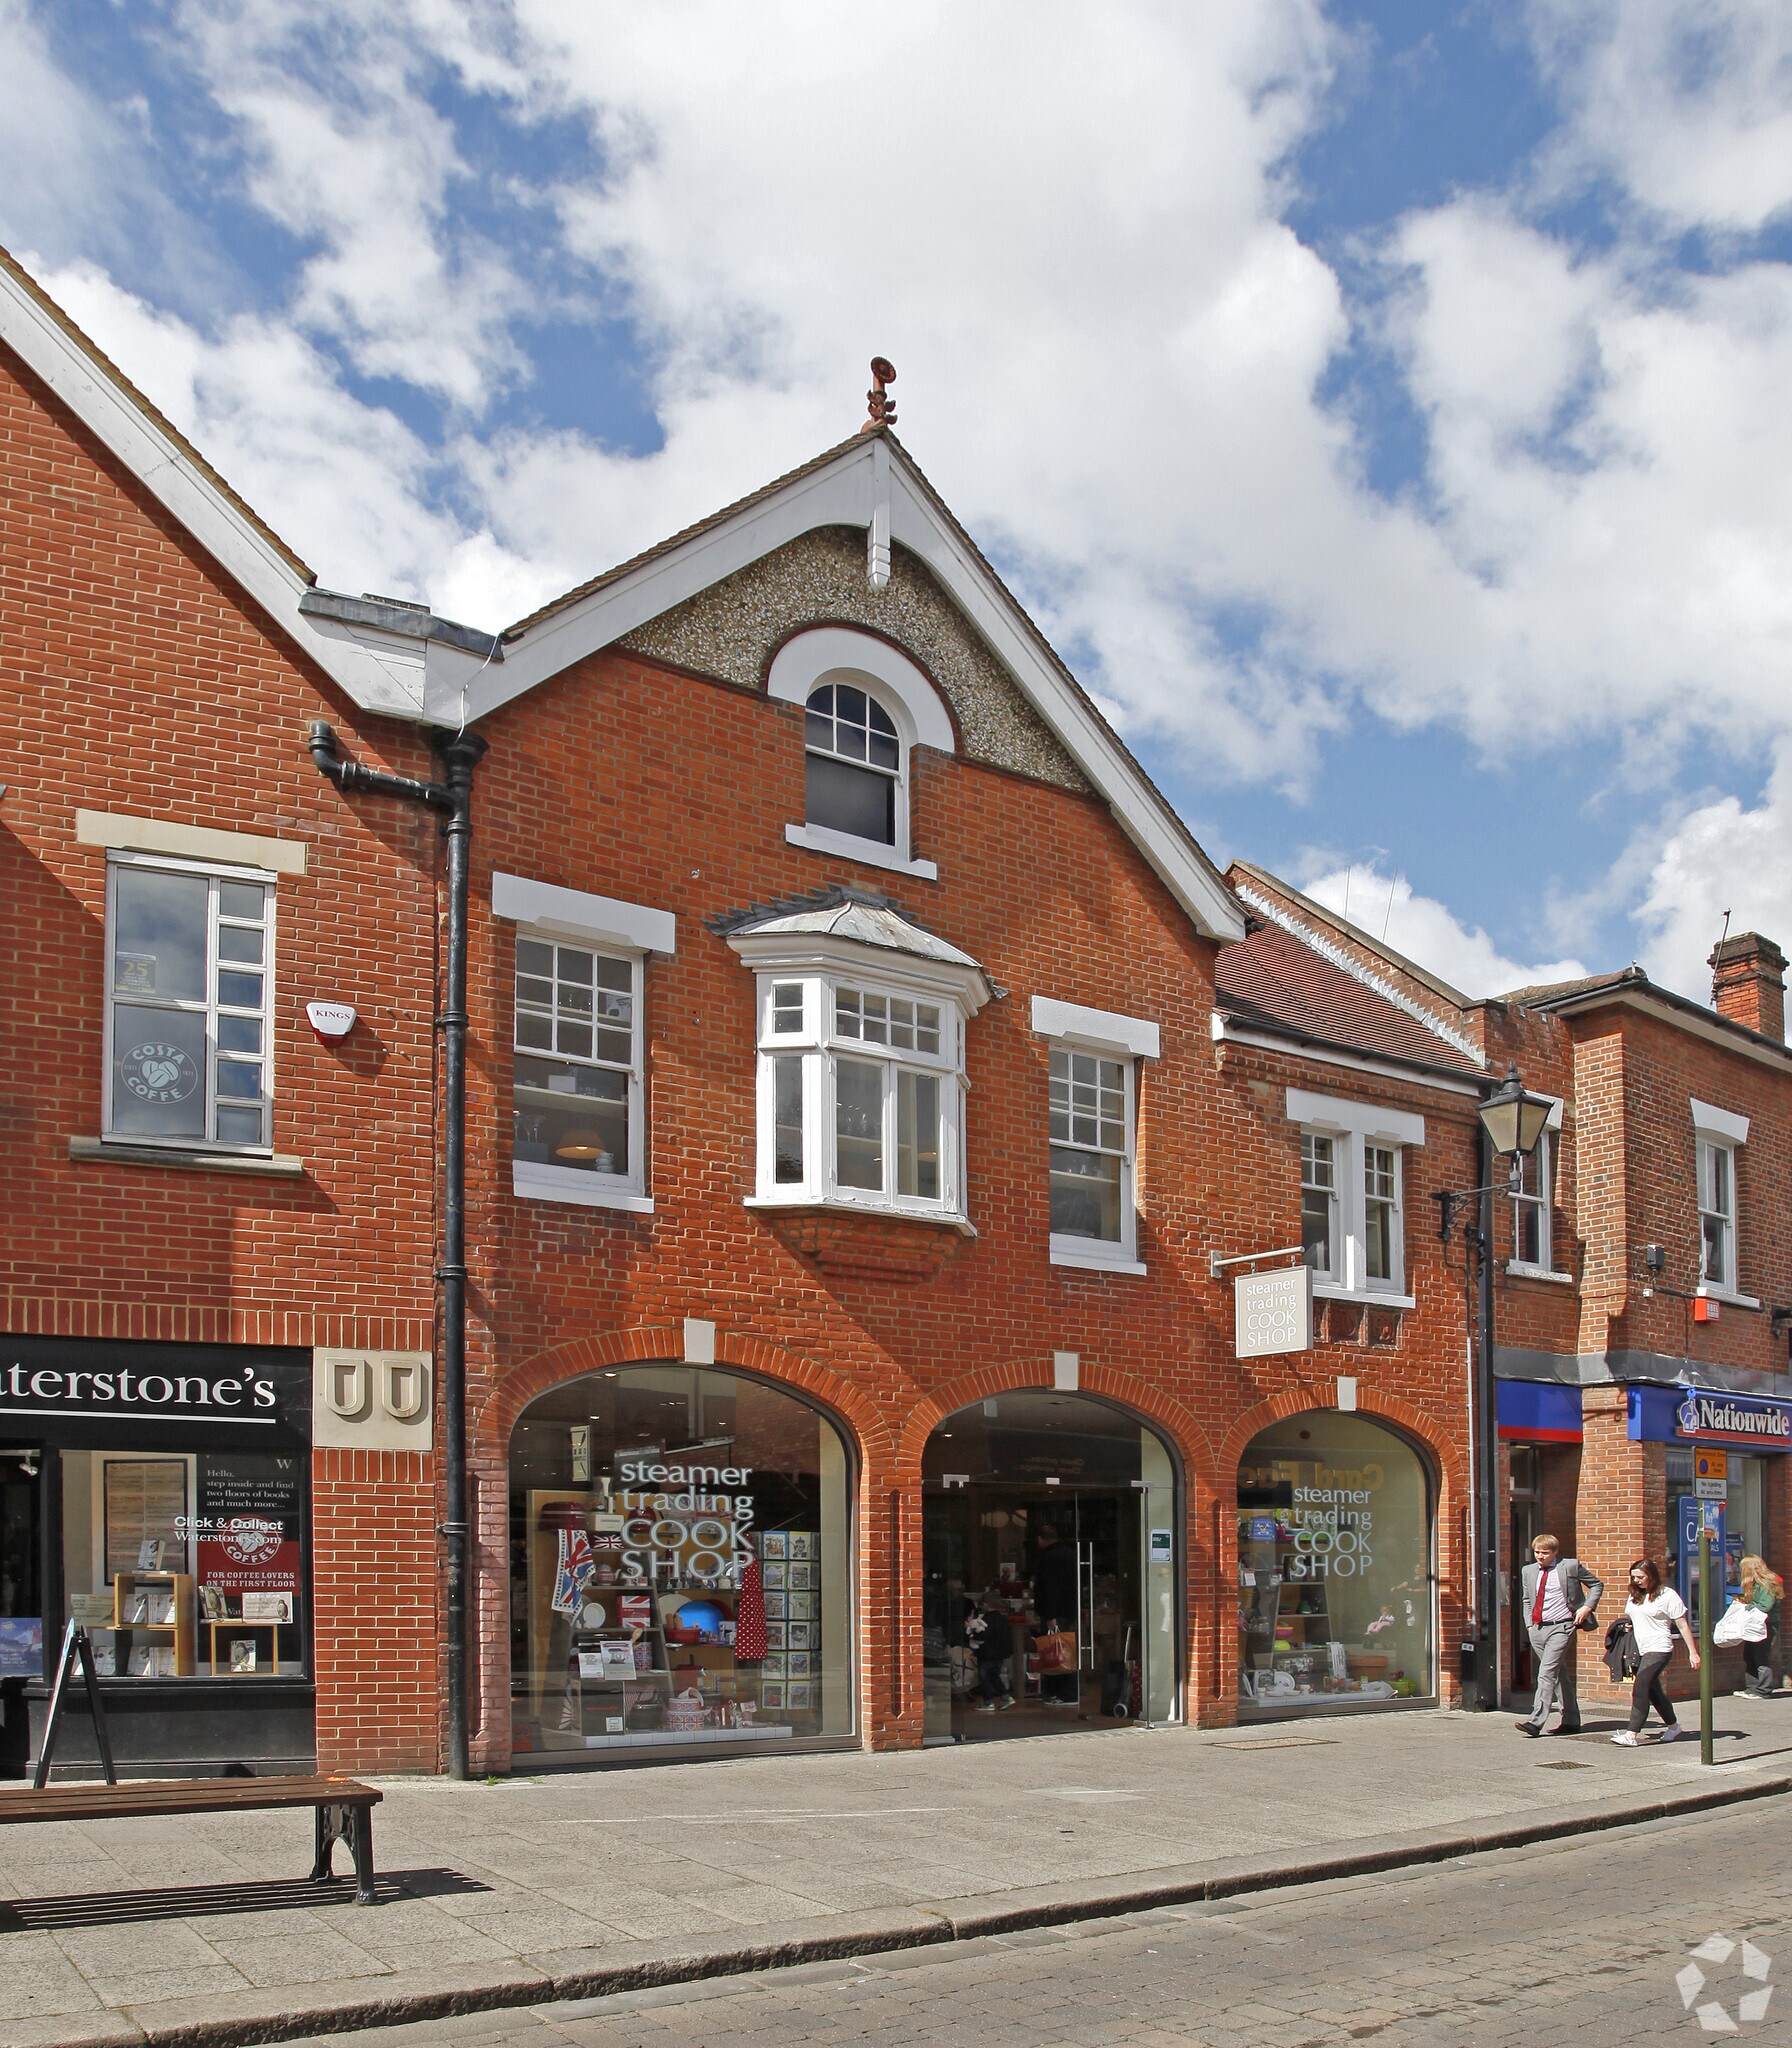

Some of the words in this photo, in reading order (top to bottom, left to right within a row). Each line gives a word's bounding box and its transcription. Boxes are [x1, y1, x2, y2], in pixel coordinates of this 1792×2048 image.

[316, 1010, 350, 1020] KINGS
[132, 1045, 186, 1065] COSTA
[1246, 1279, 1296, 1296] steamer
[1247, 1293, 1297, 1312] trading
[1247, 1309, 1297, 1330] COOK
[1247, 1327, 1297, 1348] SHOP
[0, 1363, 276, 1407] terstone's
[1700, 1399, 1790, 1436] Nationwide
[276, 1458, 293, 1469] W
[620, 1460, 753, 1486] steamer
[207, 1481, 226, 1489] step
[227, 1480, 255, 1488] inside
[276, 1481, 294, 1489] find
[252, 1490, 261, 1498] of
[622, 1484, 754, 1520] trading
[1294, 1486, 1372, 1504] steamer
[174, 1516, 213, 1528] Click
[216, 1517, 227, 1528] &
[230, 1518, 284, 1530] Collect
[1294, 1504, 1373, 1531] trading
[621, 1518, 754, 1550] COOK
[1294, 1530, 1372, 1554] COOK
[226, 1546, 275, 1563] COFFEE
[621, 1550, 754, 1579] SHOP
[207, 1571, 225, 1579] FOR
[227, 1571, 260, 1579] COFFEE
[1294, 1554, 1373, 1578] SHOP
[239, 1580, 266, 1588] FIRST
[267, 1580, 296, 1588] FLOOR
